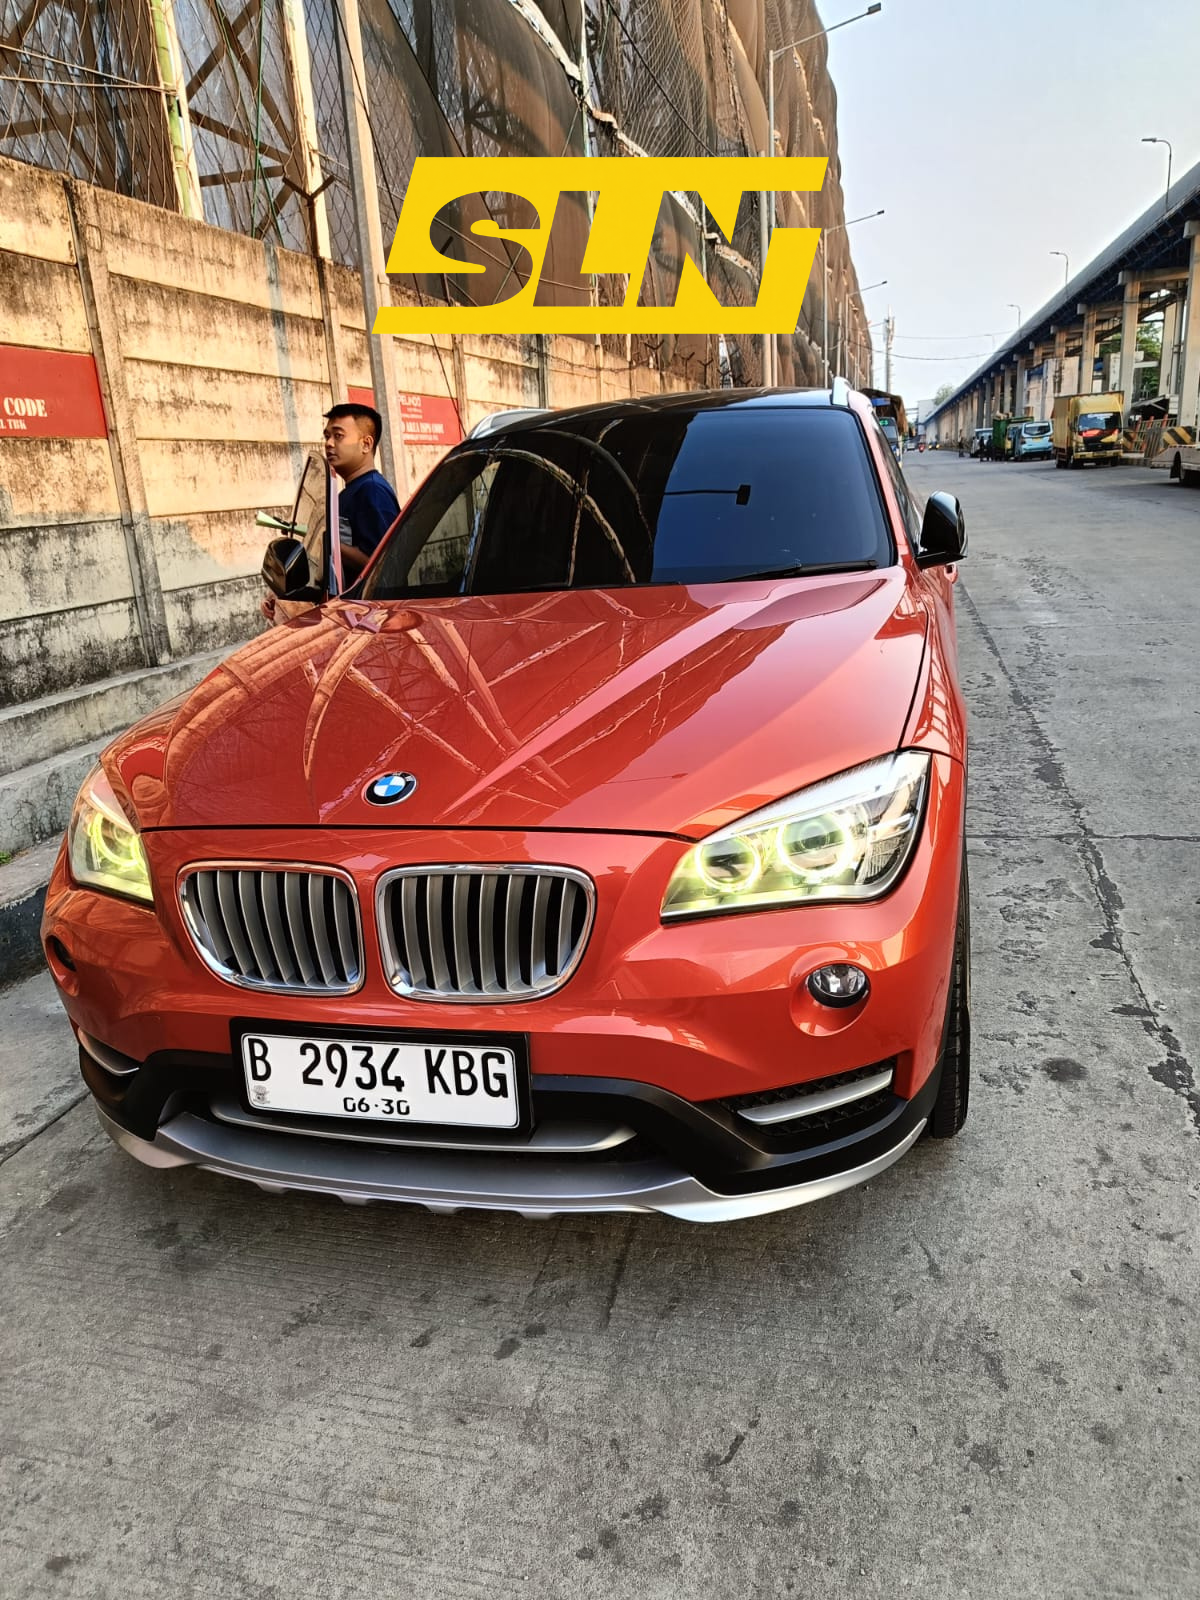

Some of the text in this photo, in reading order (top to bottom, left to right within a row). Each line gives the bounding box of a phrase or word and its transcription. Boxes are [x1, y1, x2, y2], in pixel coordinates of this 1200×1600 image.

[3, 396, 48, 417] CODE
[247, 1037, 509, 1098] B 2934 KBG
